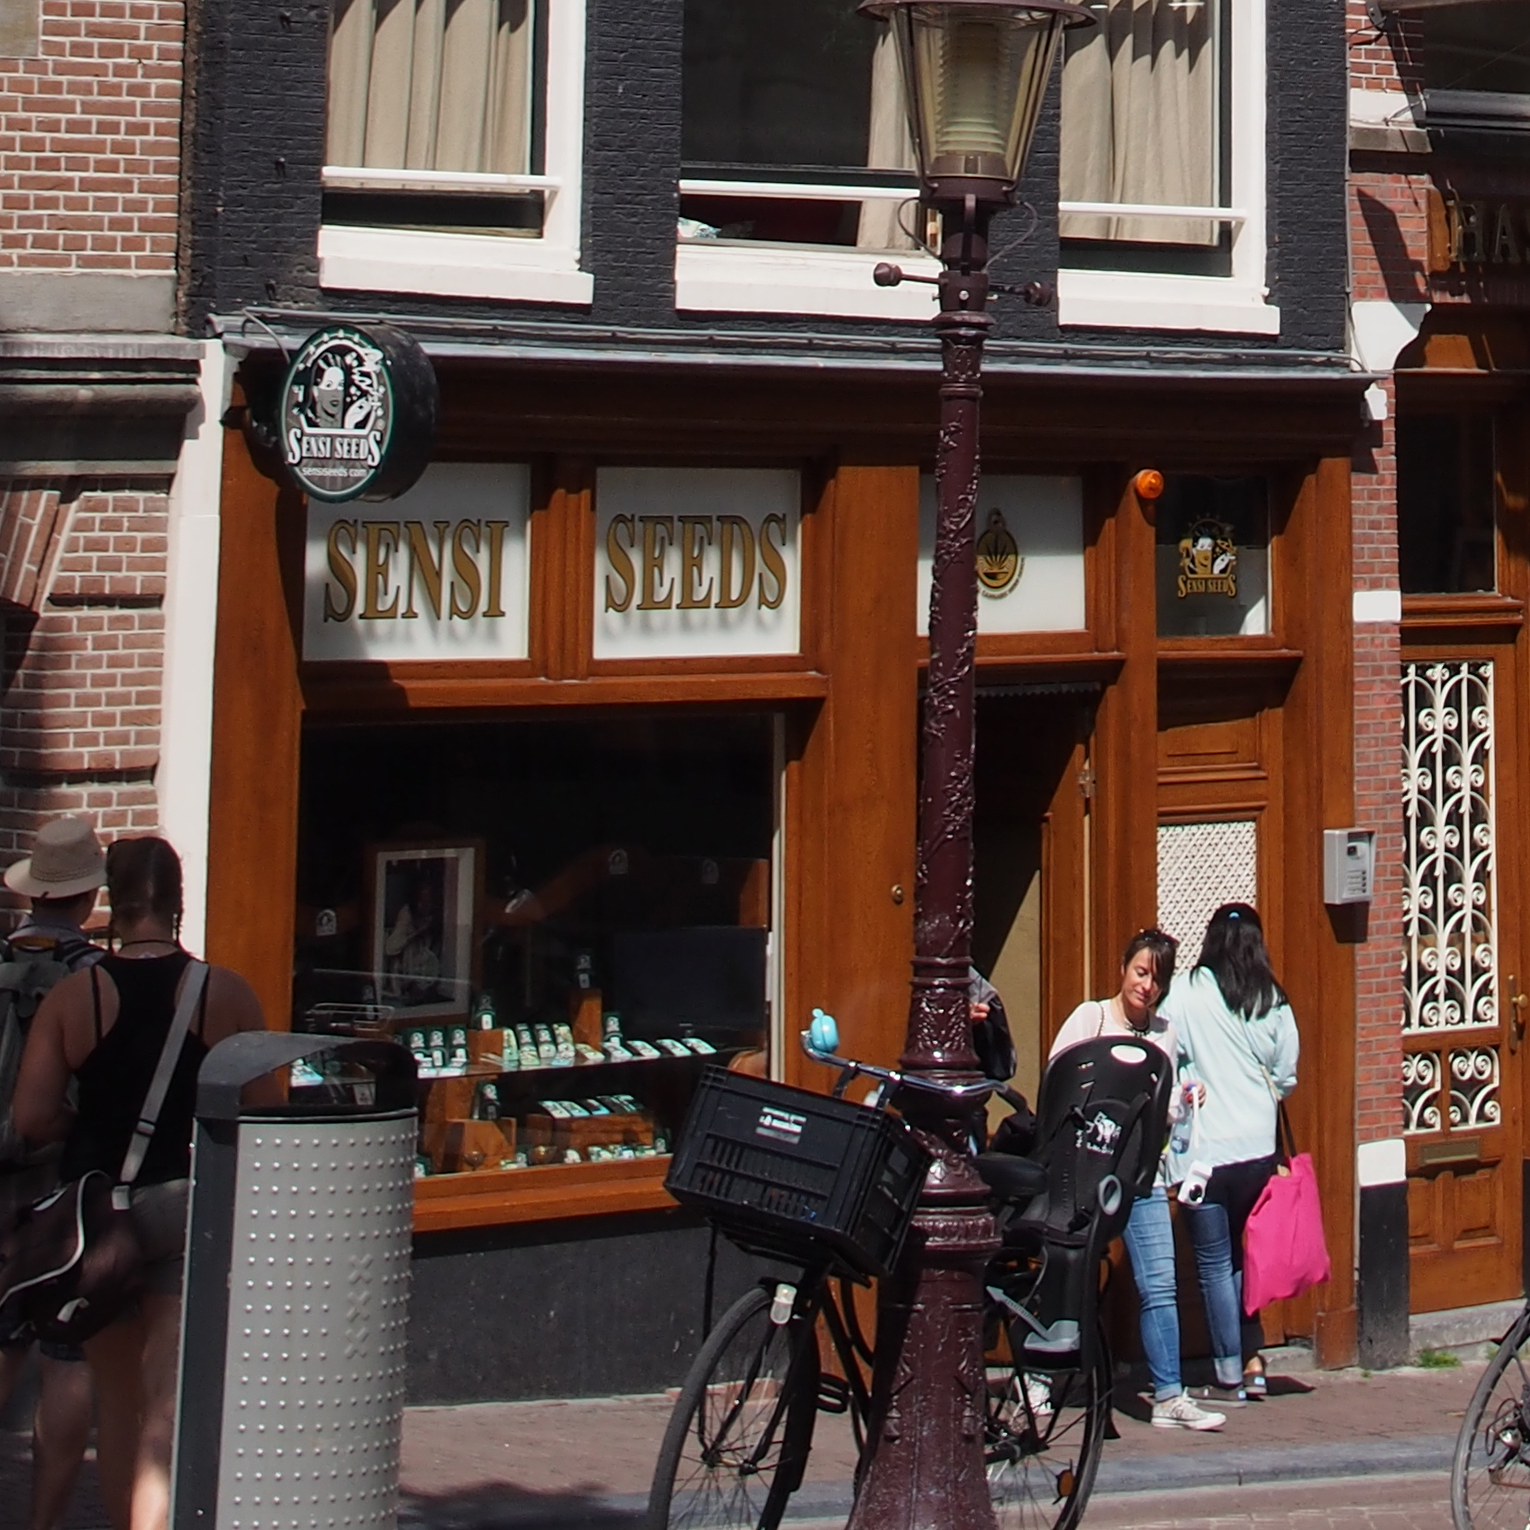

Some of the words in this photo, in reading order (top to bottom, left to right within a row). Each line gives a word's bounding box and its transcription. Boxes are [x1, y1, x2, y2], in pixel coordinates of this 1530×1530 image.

[288, 428, 332, 465] SENSI
[335, 430, 382, 467] SEEDS
[323, 519, 510, 624] SENSI
[604, 512, 787, 614] SEEDS
[1178, 574, 1206, 598] SENSI
[1207, 574, 1237, 599] SEEDS
